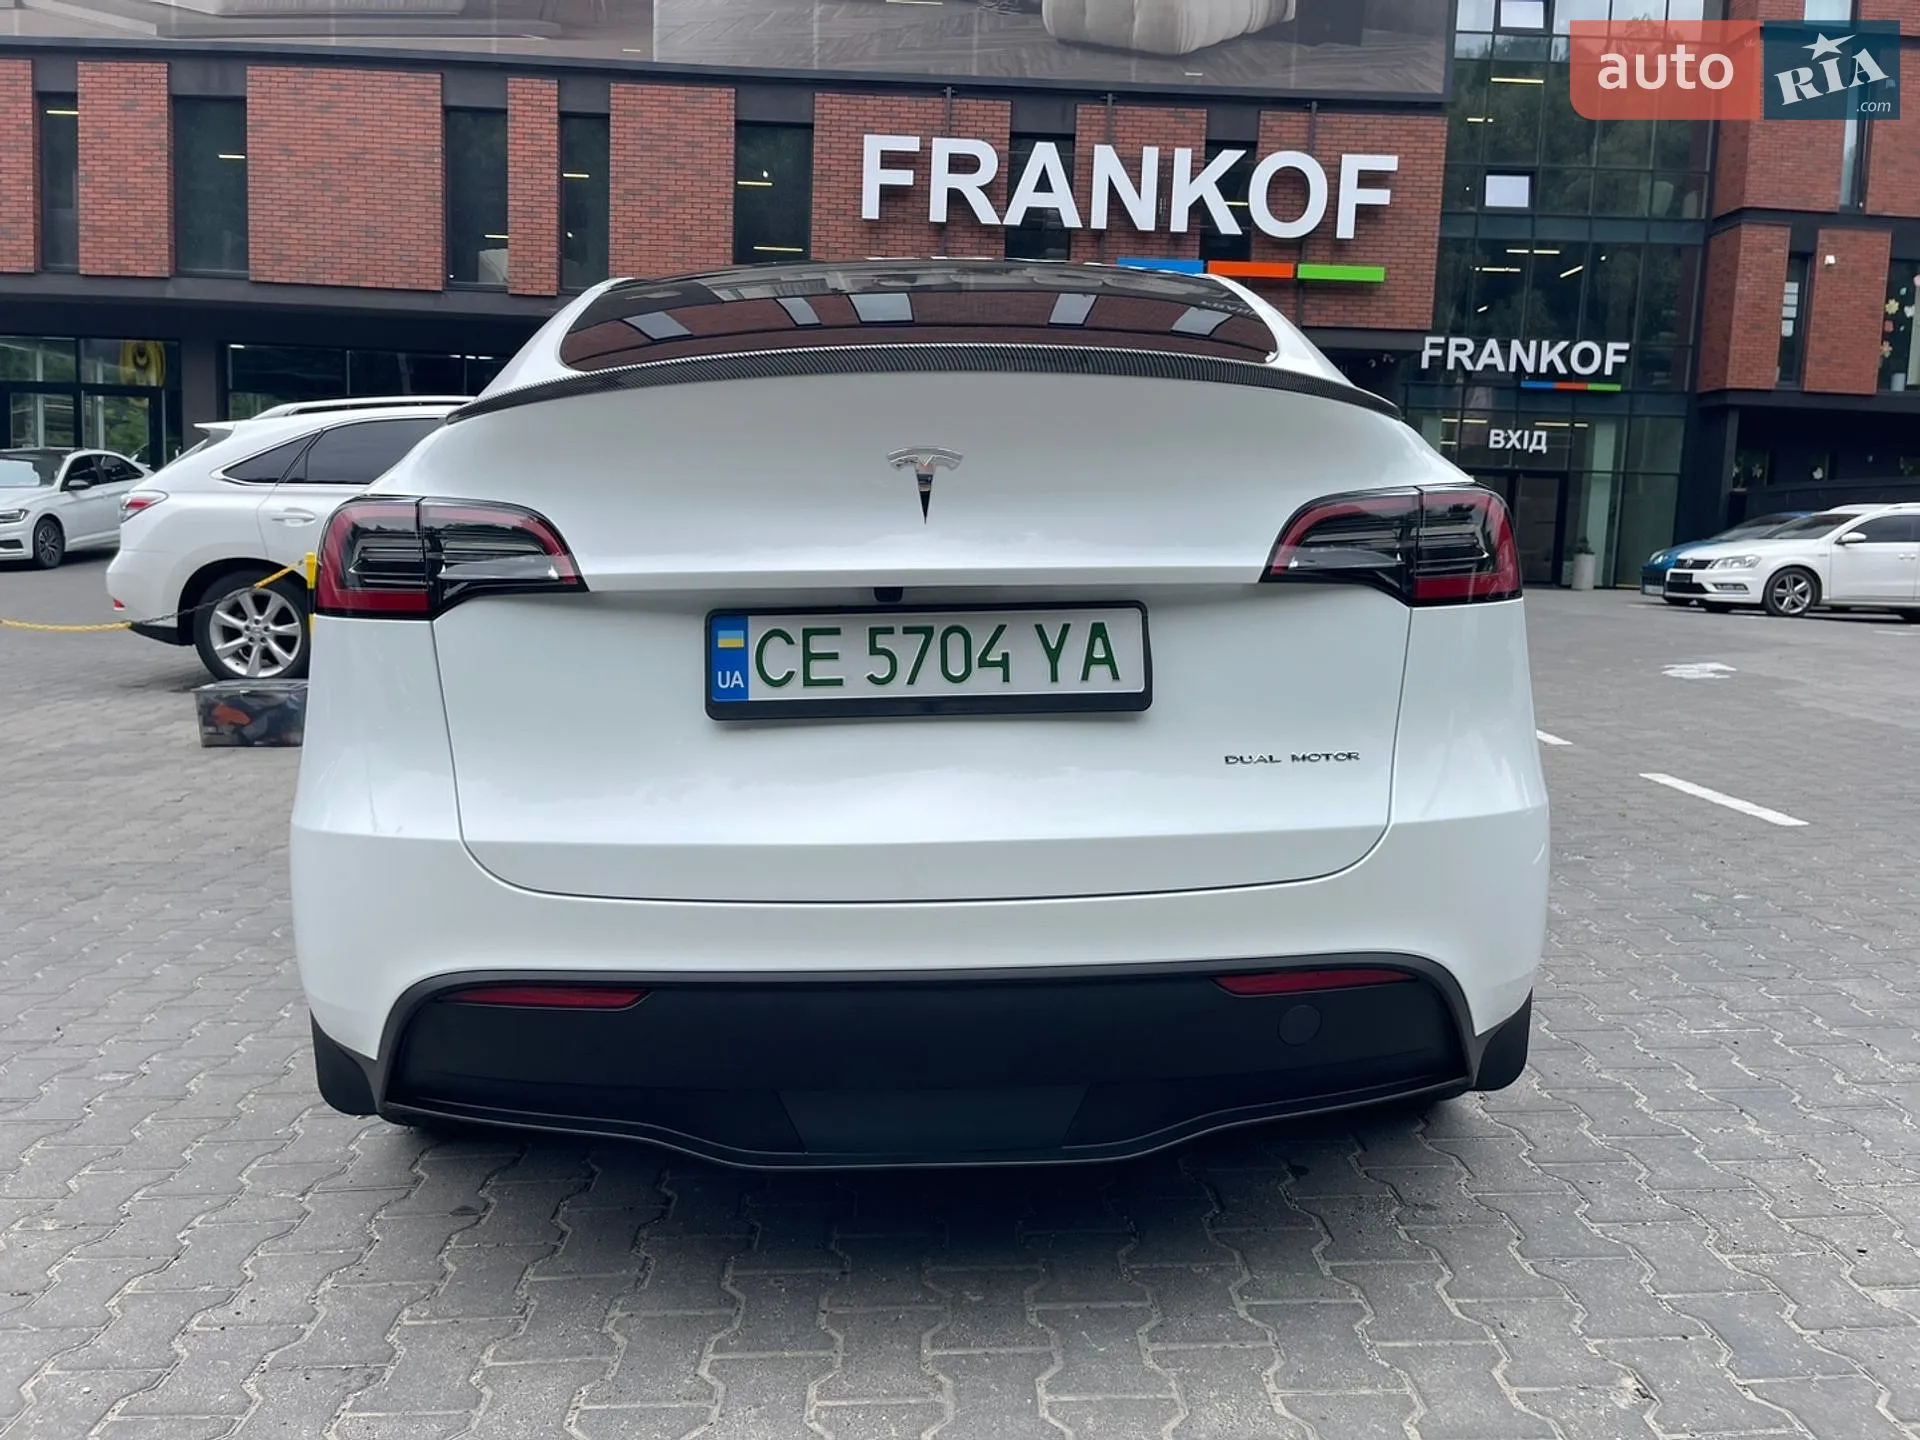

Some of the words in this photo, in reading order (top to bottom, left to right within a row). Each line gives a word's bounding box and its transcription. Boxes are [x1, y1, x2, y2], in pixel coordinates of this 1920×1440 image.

[861, 134, 1398, 240] FRANKOF
[1420, 336, 1630, 376] FRANKOF
[1488, 428, 1547, 454] ВХІД
[754, 627, 844, 688] CE
[865, 623, 1011, 686] 5704
[1034, 621, 1120, 683] YA
[717, 670, 745, 689] UA
[1224, 754, 1282, 765] DUAL
[1290, 751, 1361, 763] MOTOR
